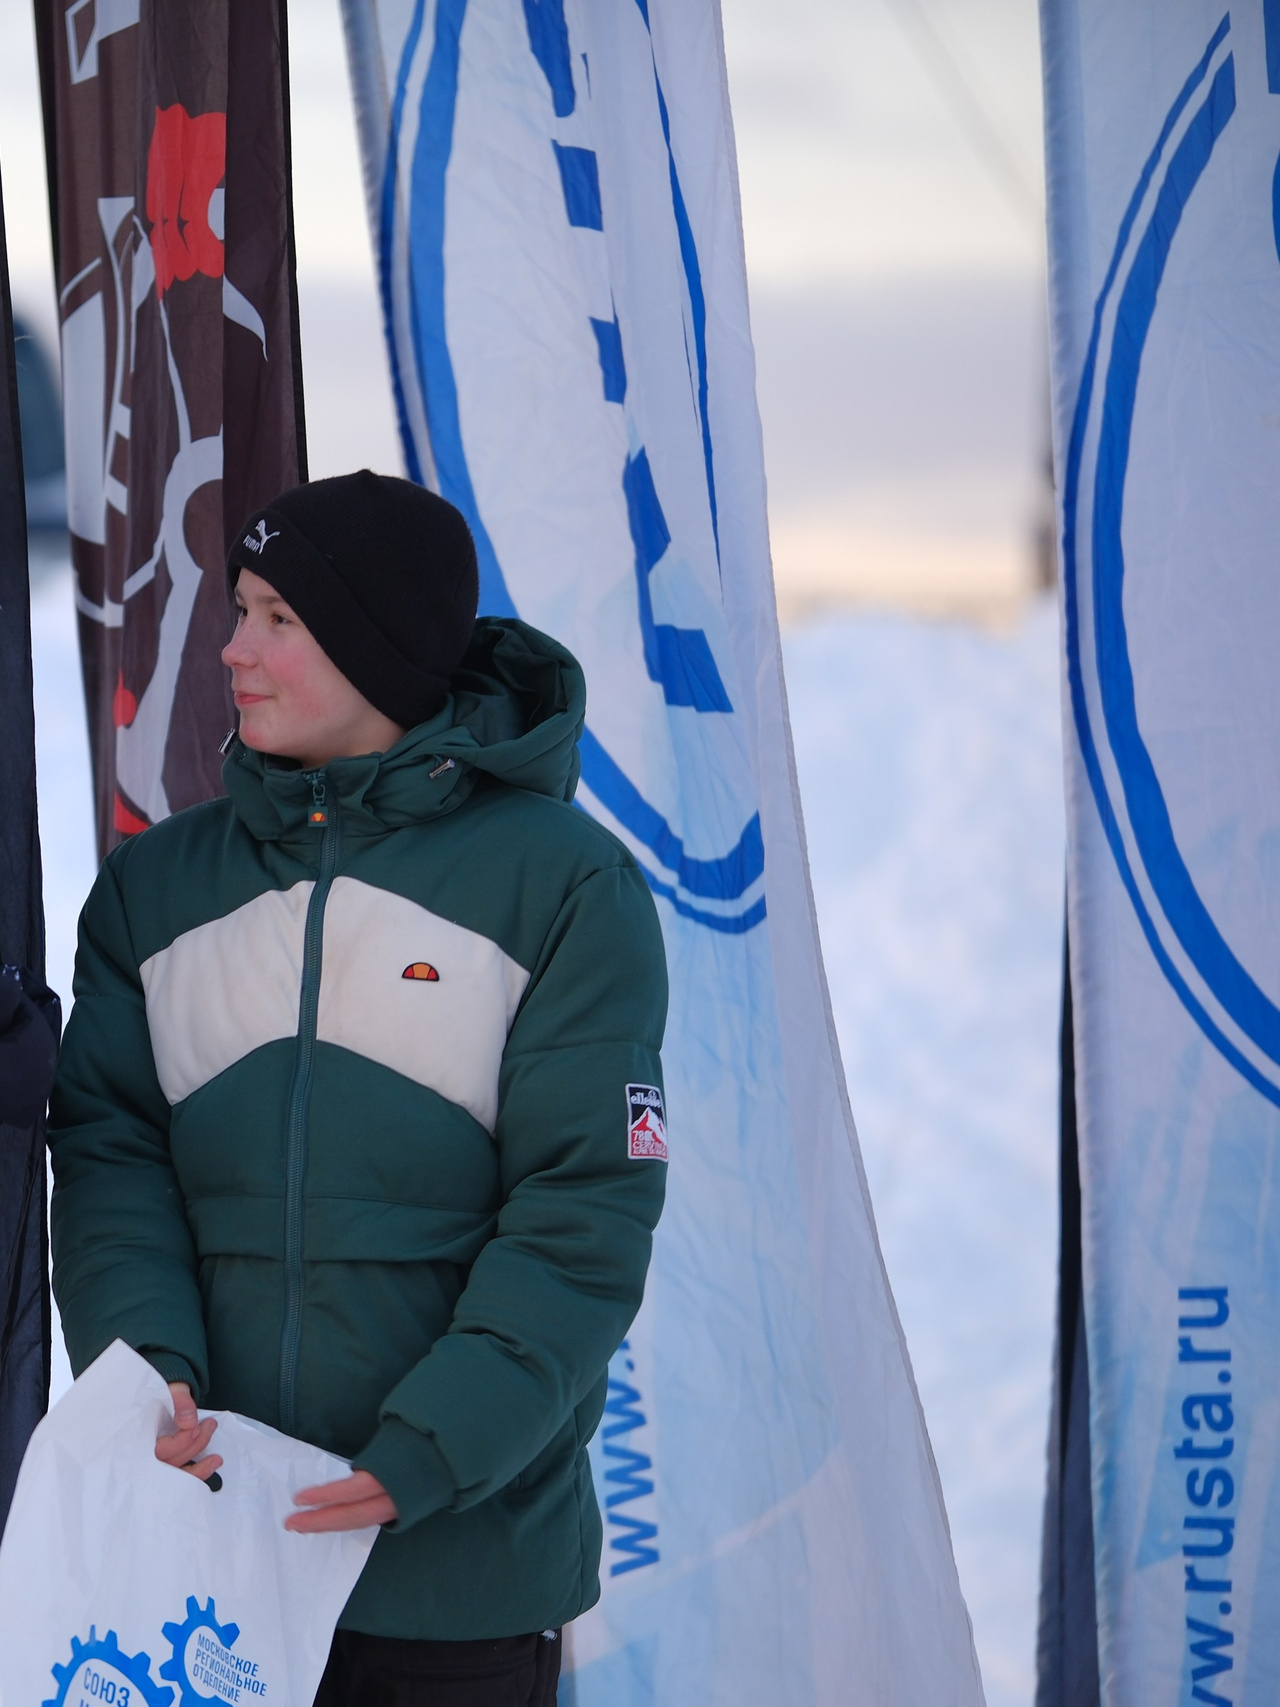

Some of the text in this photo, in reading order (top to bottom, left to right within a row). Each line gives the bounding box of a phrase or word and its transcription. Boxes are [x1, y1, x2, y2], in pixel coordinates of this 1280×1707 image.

[195, 1648, 268, 1697] РЕГИОНАЛЬНОЕ
[197, 1633, 259, 1678] МОСКОВСКОЕ
[83, 1666, 130, 1707] СОЮЗ
[192, 1663, 241, 1703] ОТДЕЛЕНИЕ
